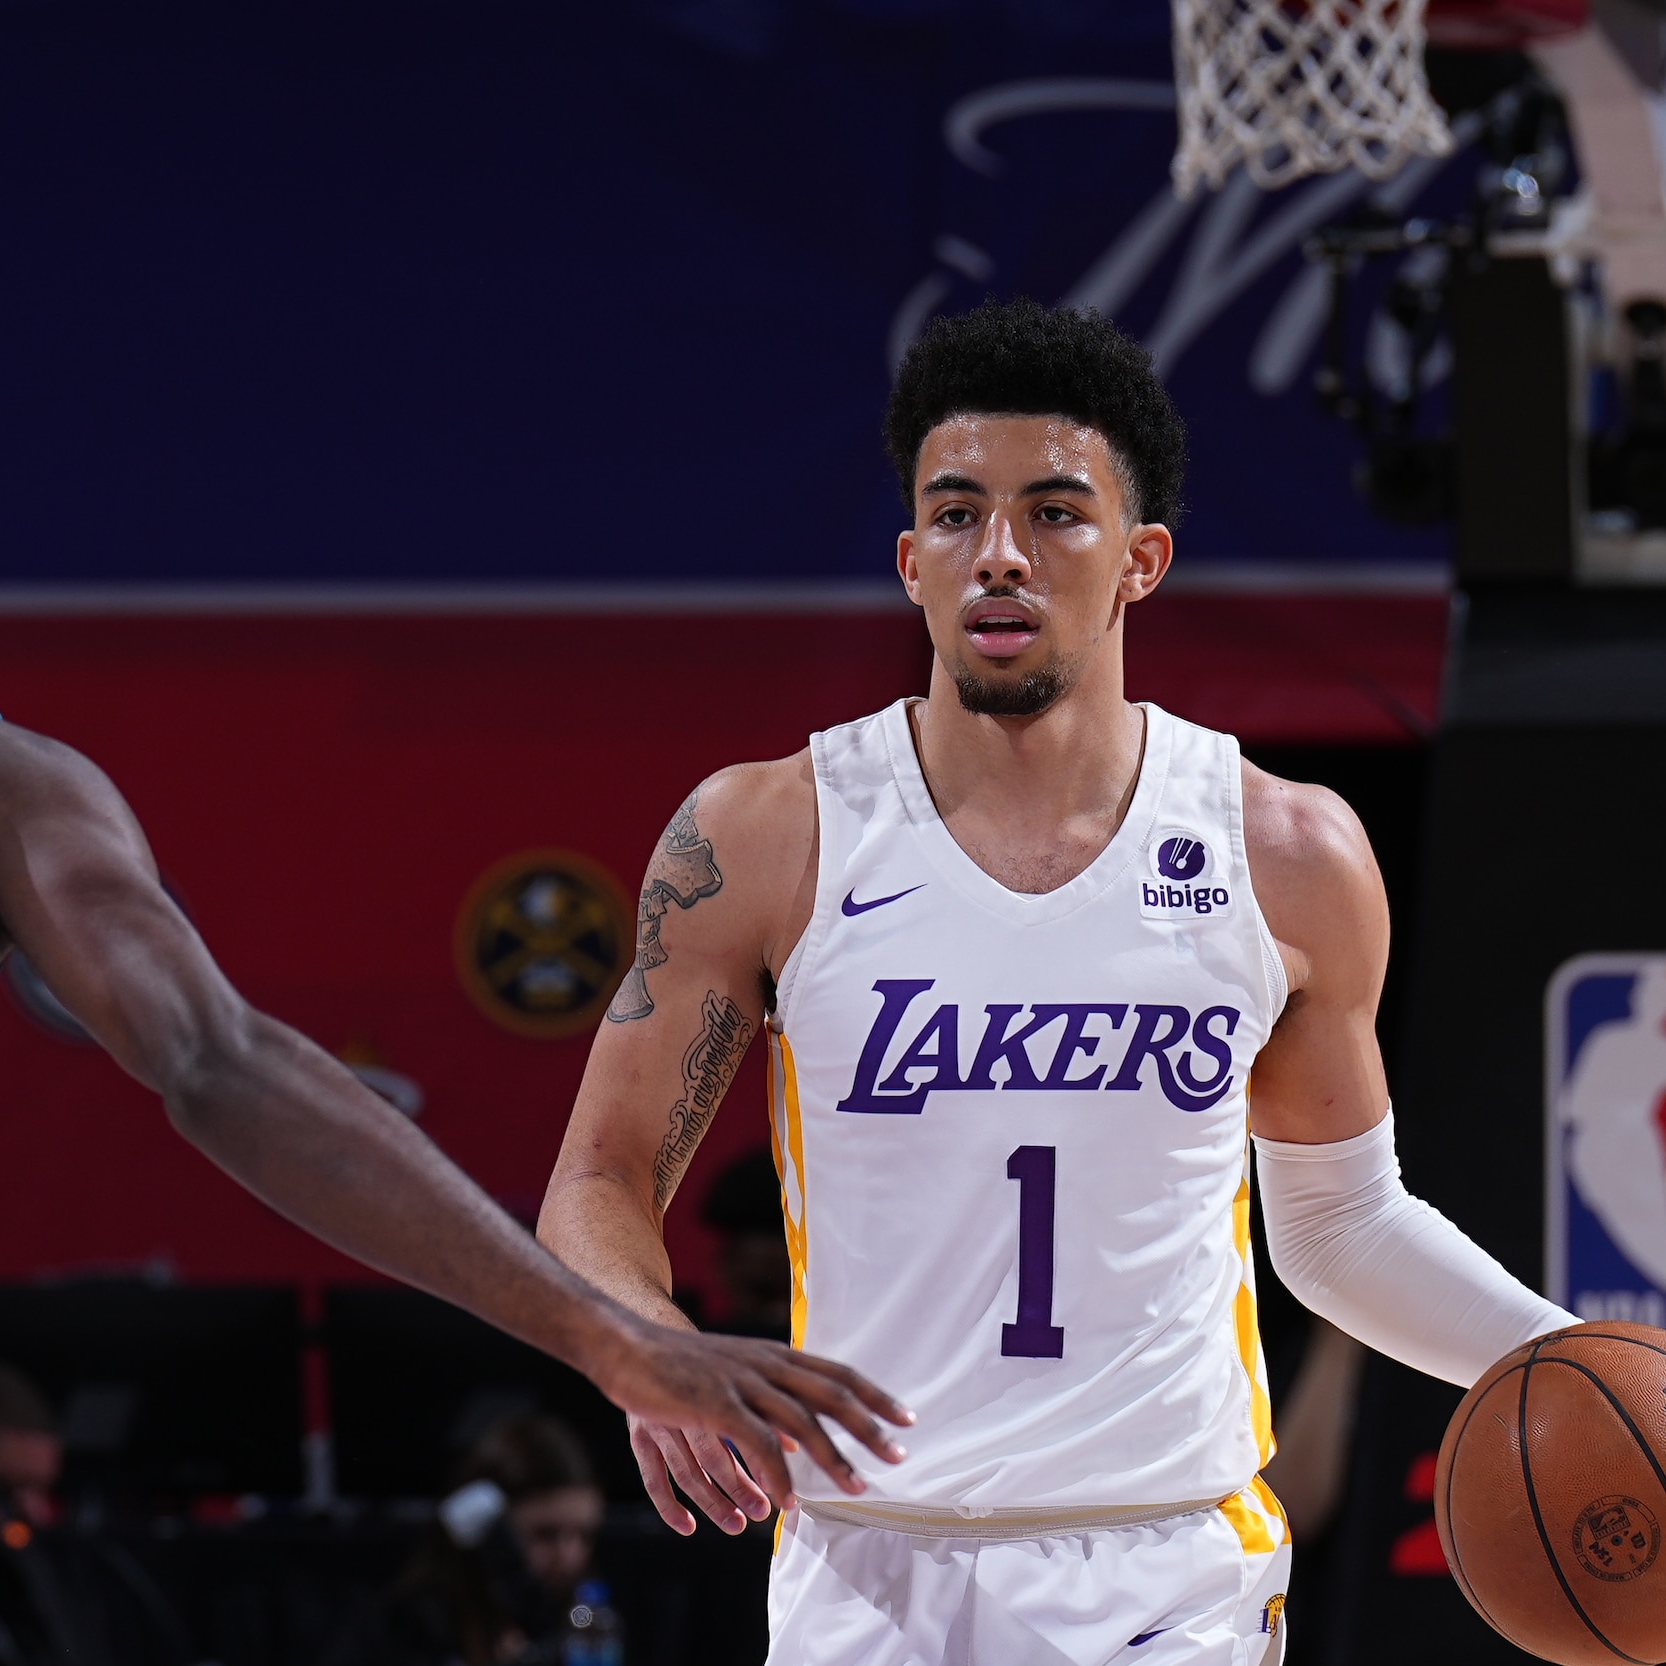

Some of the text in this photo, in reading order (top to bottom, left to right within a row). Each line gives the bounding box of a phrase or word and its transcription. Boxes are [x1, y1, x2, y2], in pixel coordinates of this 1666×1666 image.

[1142, 881, 1229, 914] bibigo
[836, 979, 1241, 1115] LAKERS
[1000, 1145, 1065, 1358] 1
